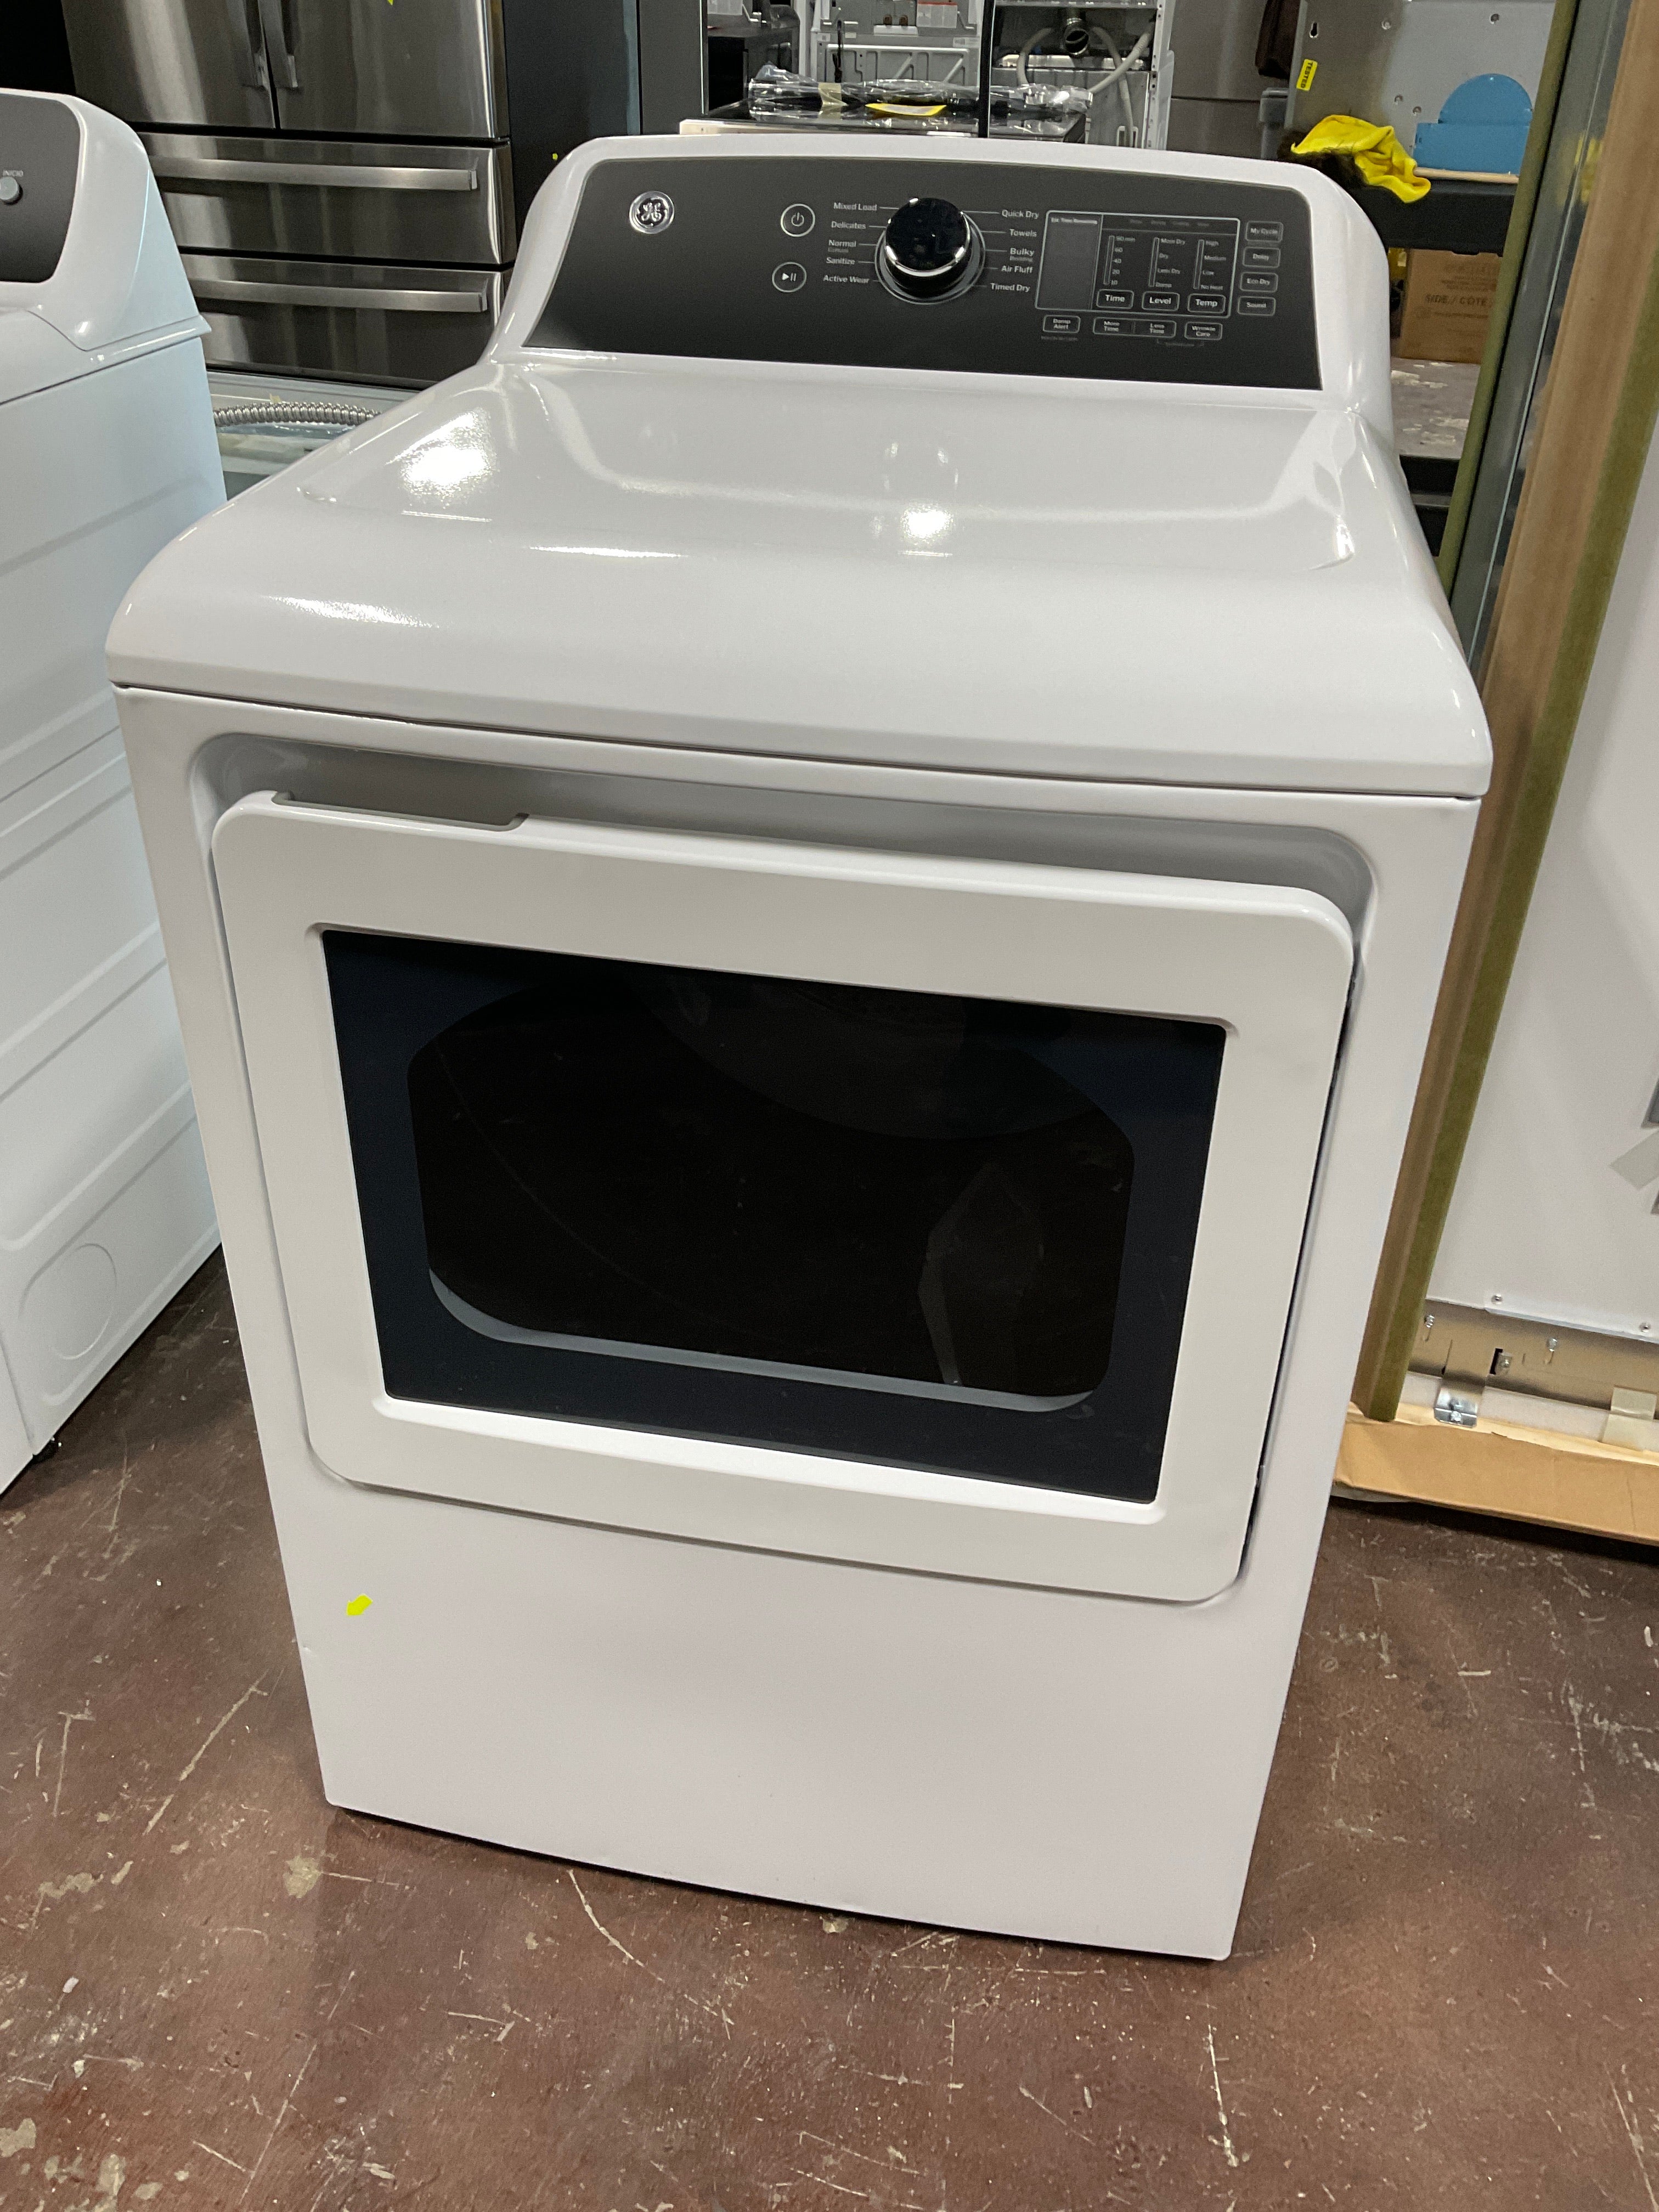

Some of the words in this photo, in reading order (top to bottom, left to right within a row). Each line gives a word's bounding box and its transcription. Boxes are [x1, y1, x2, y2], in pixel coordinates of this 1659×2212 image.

[833, 202, 857, 211] Mixed
[1002, 209, 1024, 218] Quick
[1025, 211, 1039, 219] Dry
[831, 221, 866, 229] Delicates
[1009, 228, 1037, 238] Towels
[828, 239, 856, 248] Normal
[1010, 247, 1035, 257] Bulky
[826, 257, 856, 265] Sanitize
[823, 274, 848, 283] Active
[990, 283, 1015, 291] Timed
[1017, 284, 1031, 292] Dry
[1105, 294, 1125, 302] Time
[1149, 296, 1171, 304] Level
[1195, 298, 1218, 308] Temp
